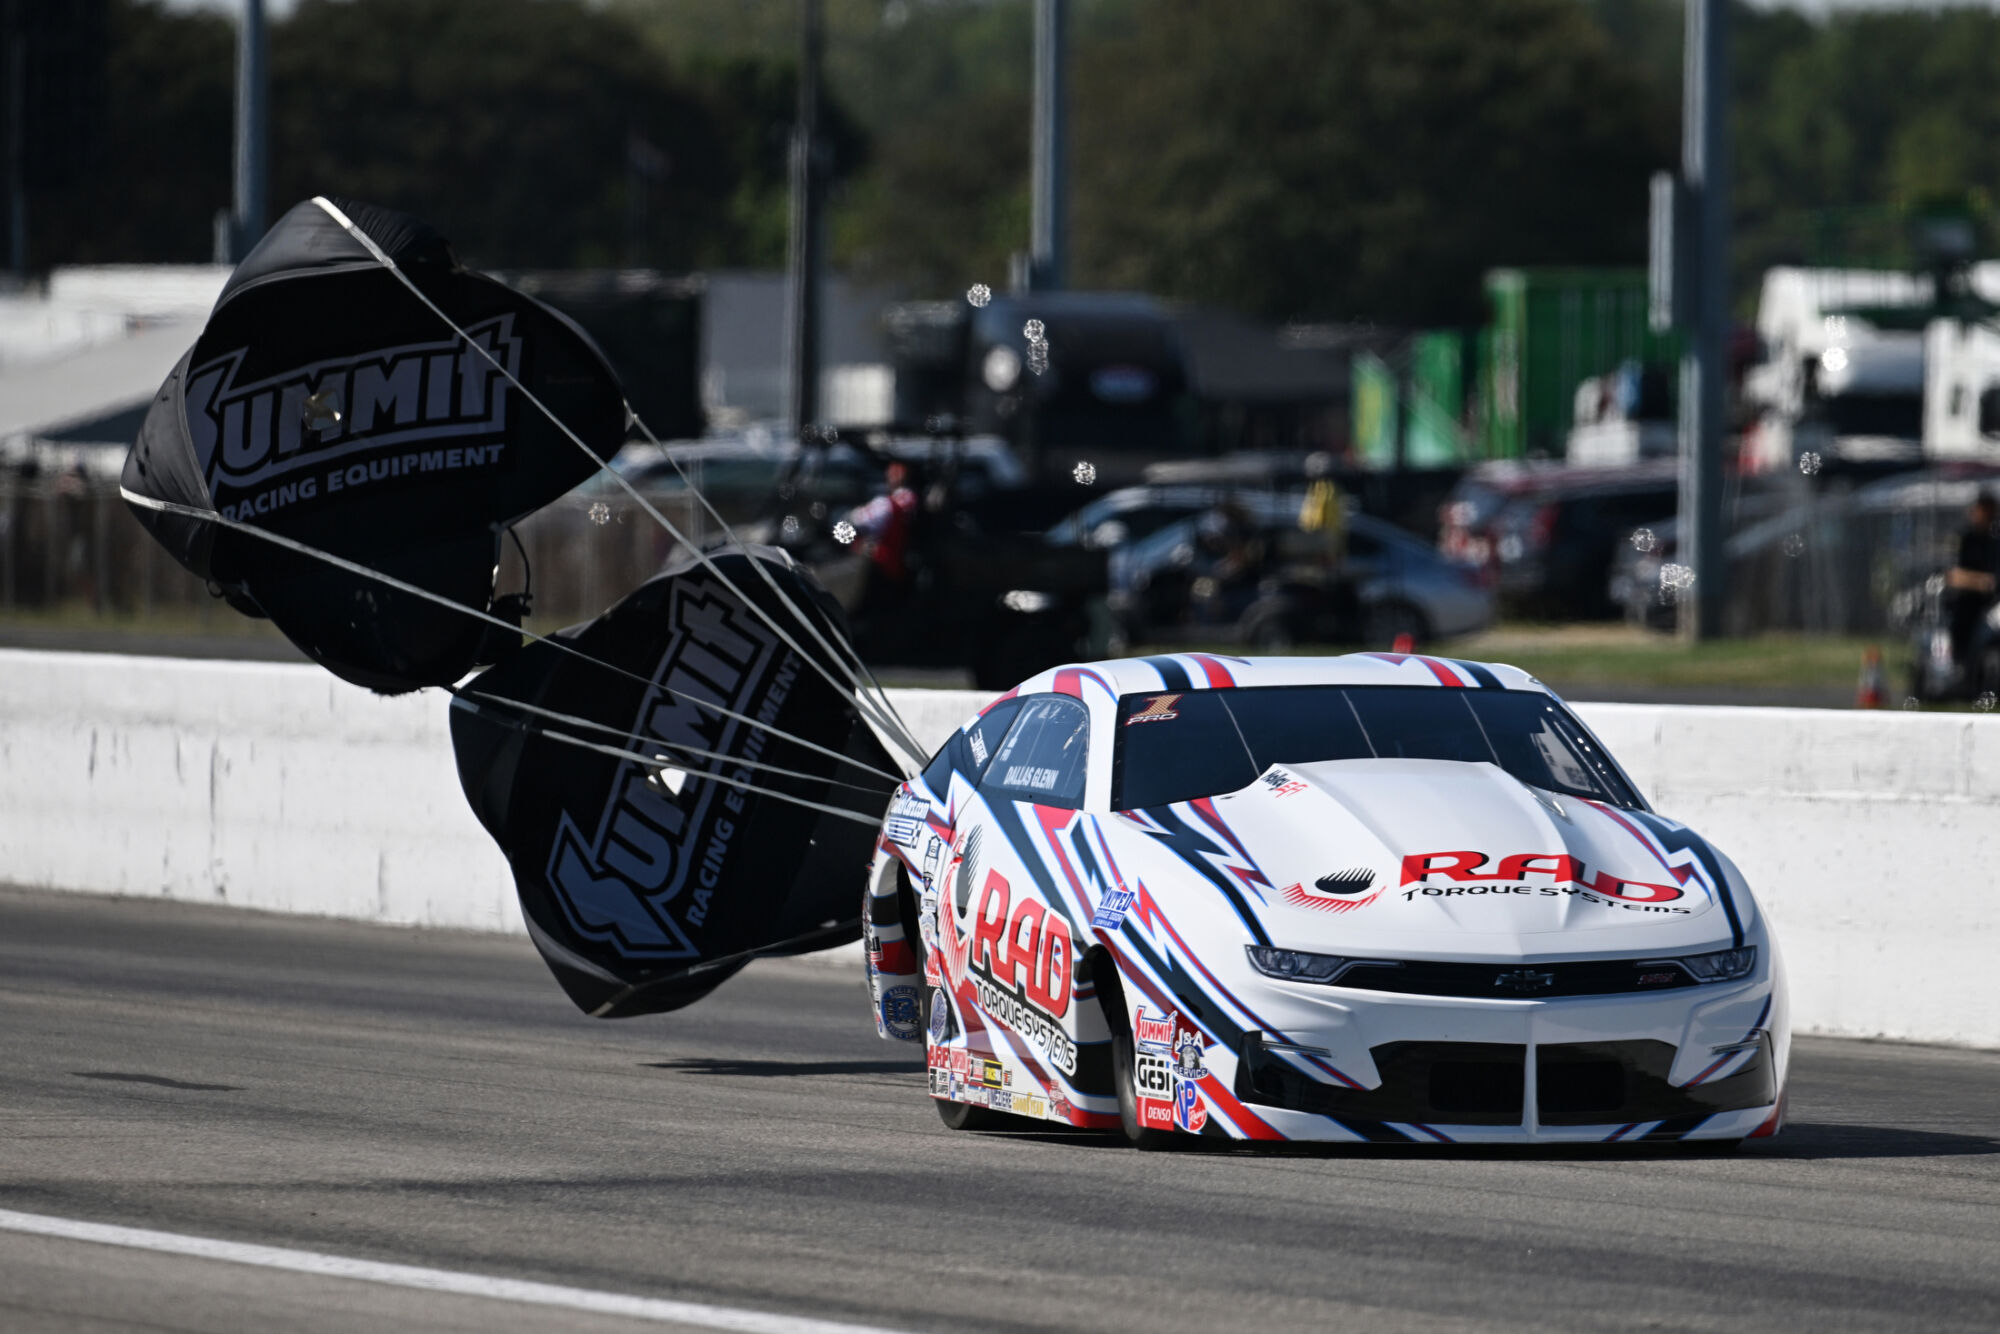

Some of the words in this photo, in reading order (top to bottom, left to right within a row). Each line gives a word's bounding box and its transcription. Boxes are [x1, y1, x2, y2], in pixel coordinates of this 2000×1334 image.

[327, 444, 505, 493] EQUIPMENT
[1126, 712, 1178, 725] PRO
[686, 818, 735, 929] RACING
[729, 650, 801, 817] EQUIPMENT
[1003, 765, 1035, 787] DALLAS
[1030, 767, 1060, 790] GLENN
[1400, 850, 1685, 903] RAD
[1100, 886, 1136, 912] UNITED
[1402, 885, 1532, 902] TORQUE
[1539, 887, 1692, 914] SYSTEMS
[972, 867, 1073, 1019] RAD
[974, 978, 1026, 1031] TORQUE
[1022, 1008, 1078, 1077] SYSTEMS
[1174, 1028, 1205, 1057] J&A
[1173, 1064, 1209, 1078] SERVICE
[1148, 1106, 1172, 1122] DENSO
[1176, 1080, 1197, 1129] VP
